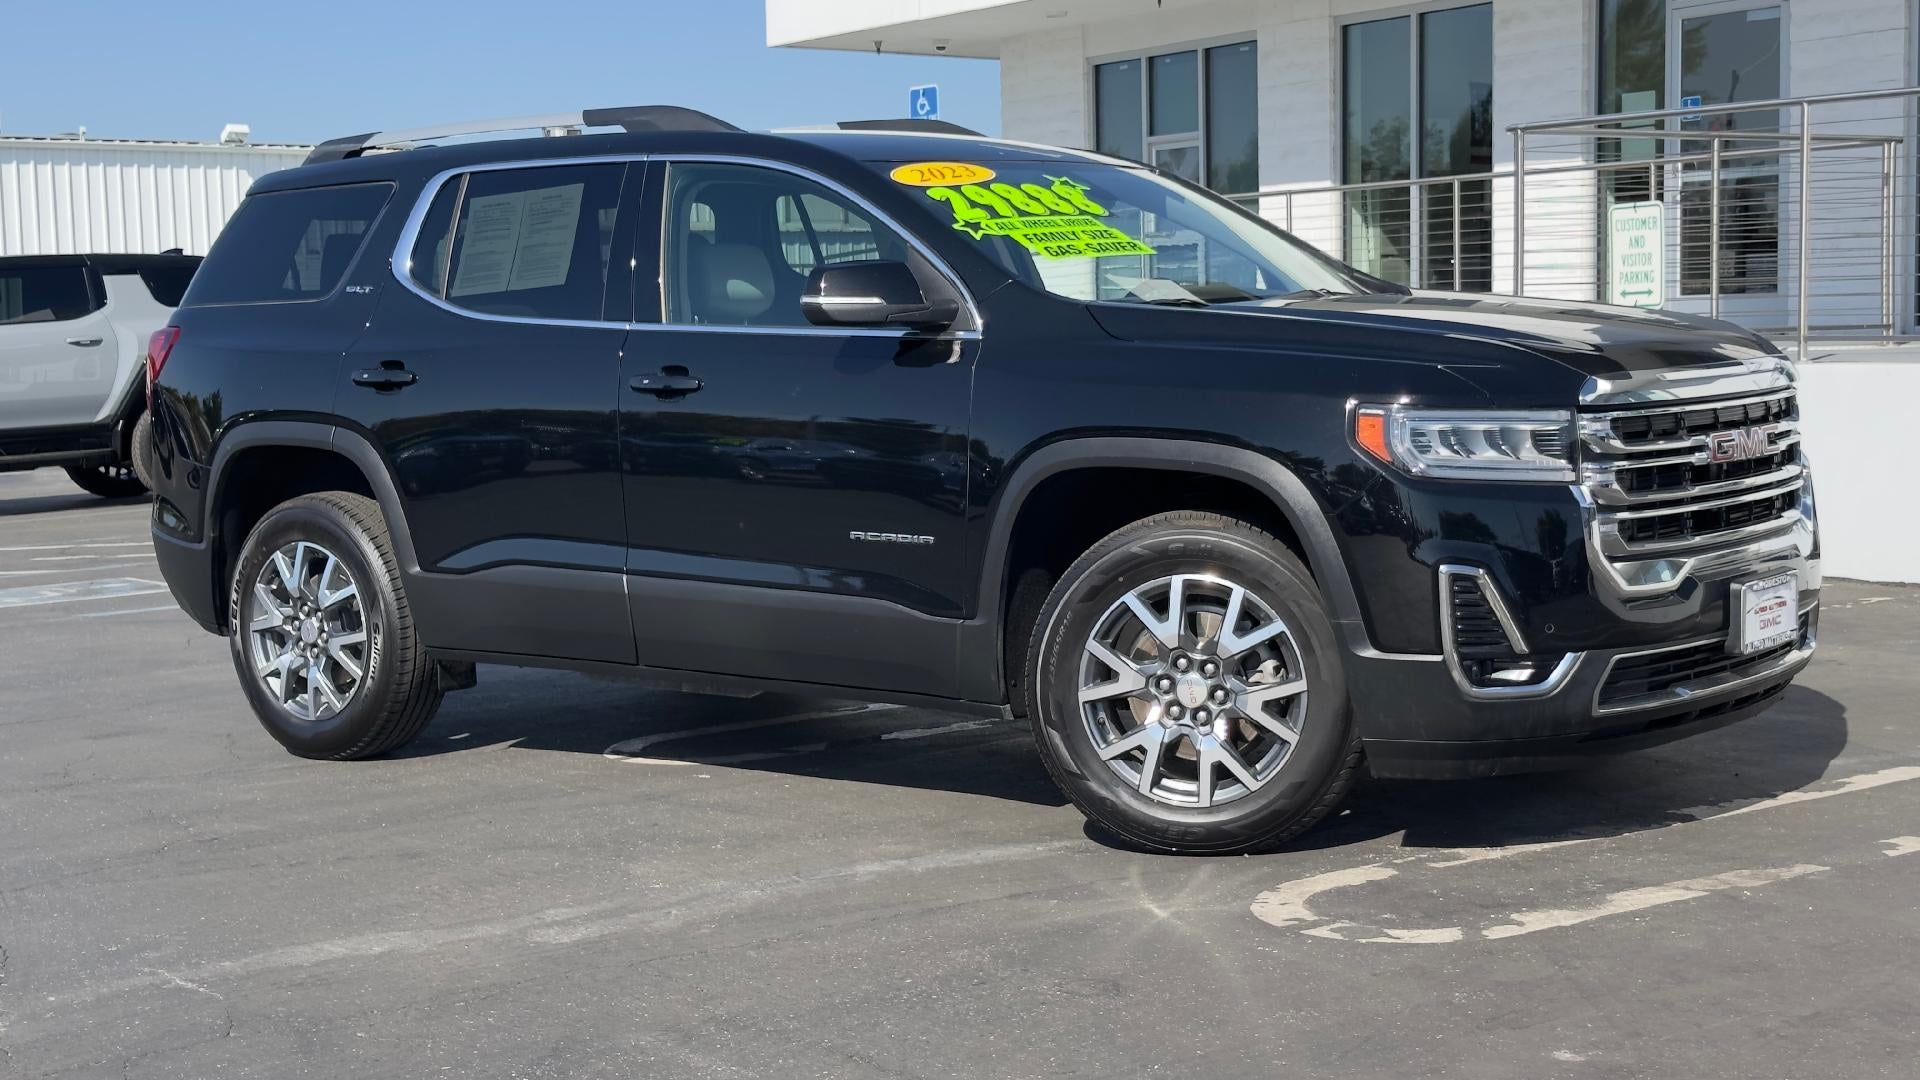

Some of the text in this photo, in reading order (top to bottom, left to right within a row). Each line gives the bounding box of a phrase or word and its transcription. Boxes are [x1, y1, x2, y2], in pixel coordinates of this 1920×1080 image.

[910, 165, 976, 183] 2023
[995, 217, 1098, 231] ALL WHEEL DRIVE
[1615, 216, 1657, 232] CUSTOMER
[1023, 229, 1119, 244] FAMILY SIZE
[1628, 235, 1646, 249] AND
[1621, 252, 1652, 267] VISITOR
[1619, 270, 1654, 285] PARKING
[345, 286, 373, 294] SLT
[1711, 423, 1781, 464] GMC
[849, 531, 935, 545] ACADIA
[1759, 614, 1782, 631] GMC
